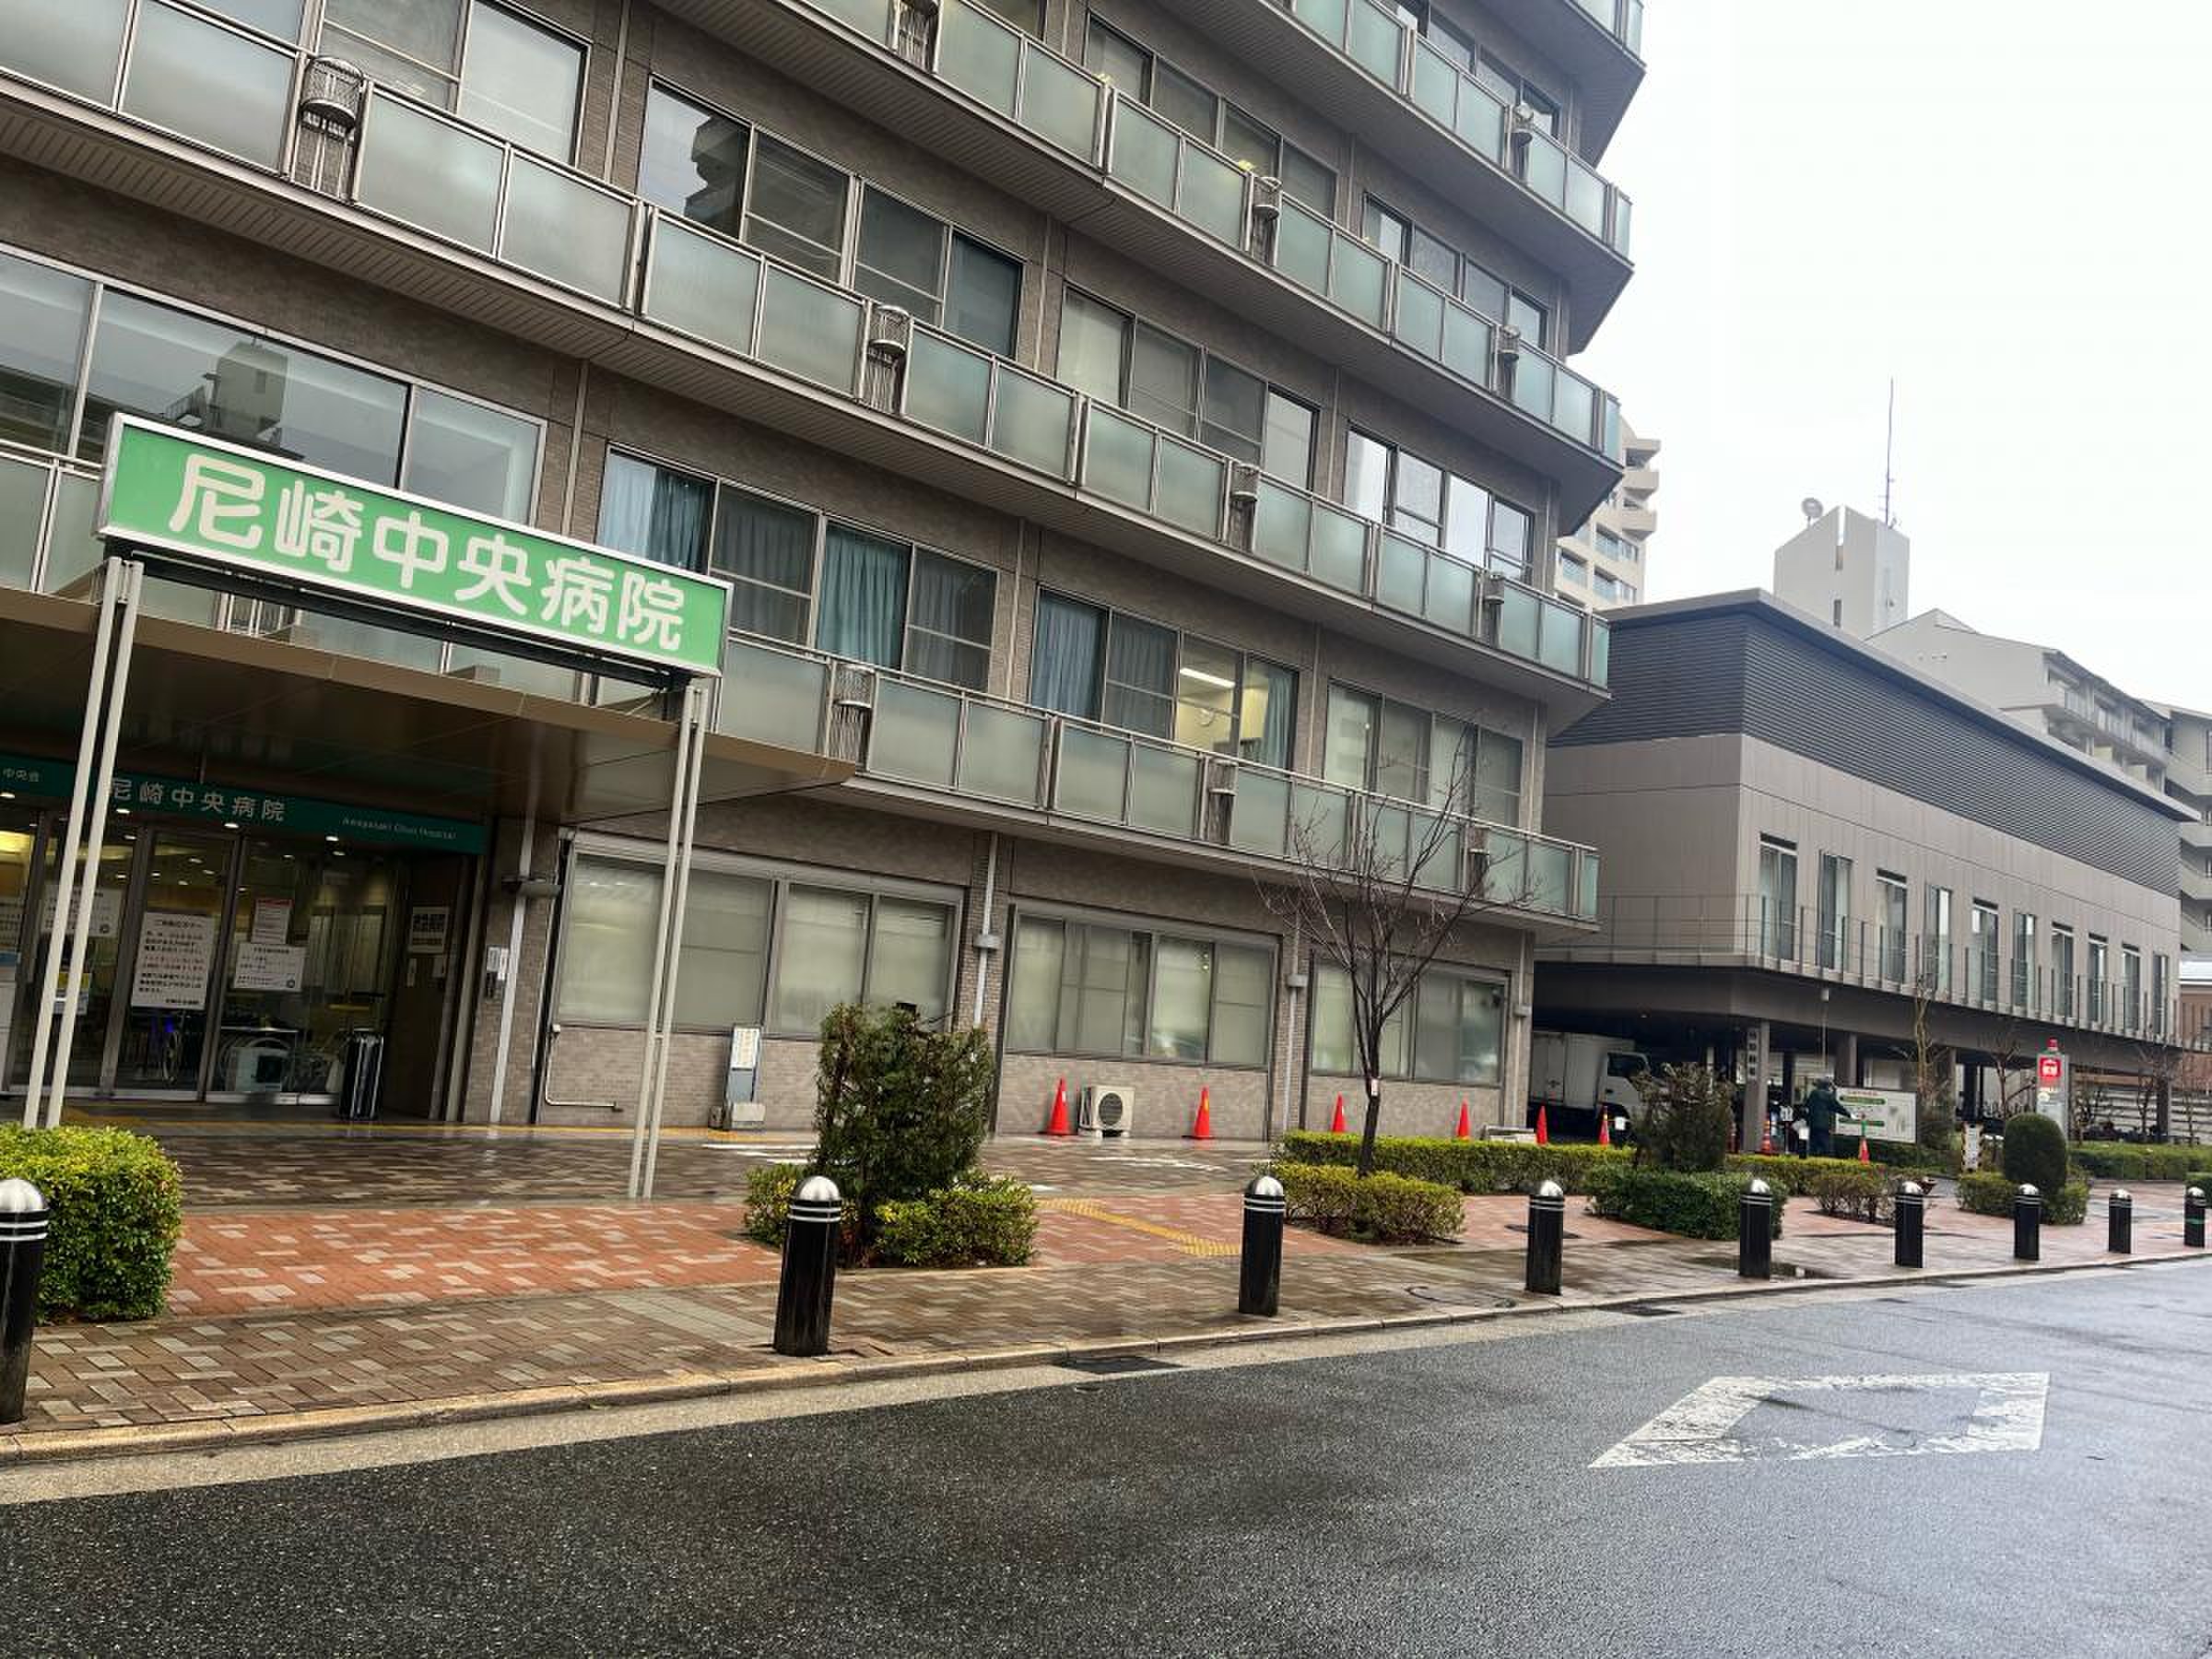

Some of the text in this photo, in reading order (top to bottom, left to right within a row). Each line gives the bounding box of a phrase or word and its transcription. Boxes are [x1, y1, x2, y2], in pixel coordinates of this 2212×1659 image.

[169, 453, 685, 651] 尼崎中央病院
[112, 777, 287, 823] 尼崎中央病院
